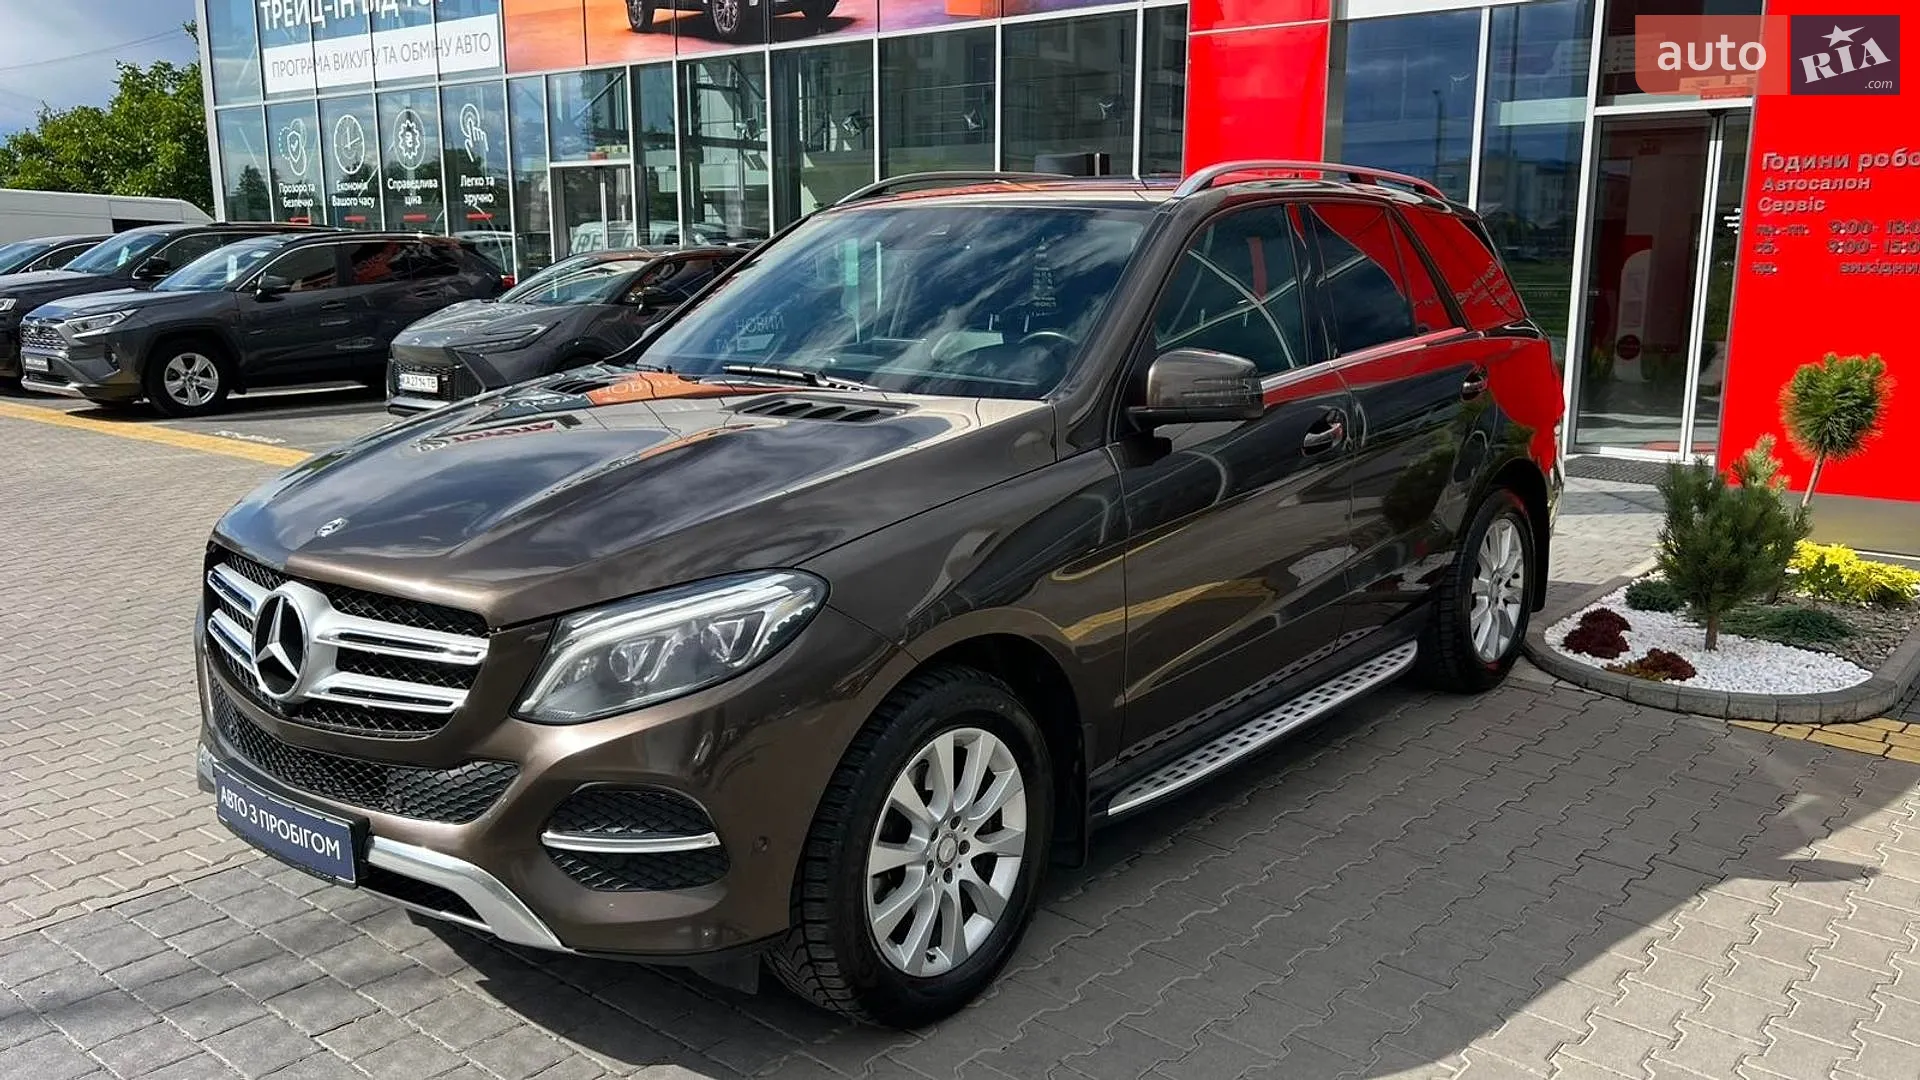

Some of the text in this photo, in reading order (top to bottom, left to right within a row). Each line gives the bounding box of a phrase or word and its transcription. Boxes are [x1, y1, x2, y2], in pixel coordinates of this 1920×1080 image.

[381, 45, 399, 65] ТА
[454, 32, 491, 56] АВТО
[1762, 152, 1849, 172] Години
[387, 178, 438, 192] Справедлива
[460, 175, 495, 187] Легко та
[1762, 177, 1870, 191] Автосалон
[279, 183, 316, 195] Прозоро та
[283, 196, 314, 208] безпечно
[332, 195, 375, 208] Вашого часу
[404, 193, 422, 206] ціна
[464, 193, 494, 206] зручно
[1758, 196, 1826, 214] Сервіс
[1840, 259, 1920, 275] вихідни
[220, 786, 248, 818] АВТО
[259, 810, 341, 861] ПРОБІГОМ
